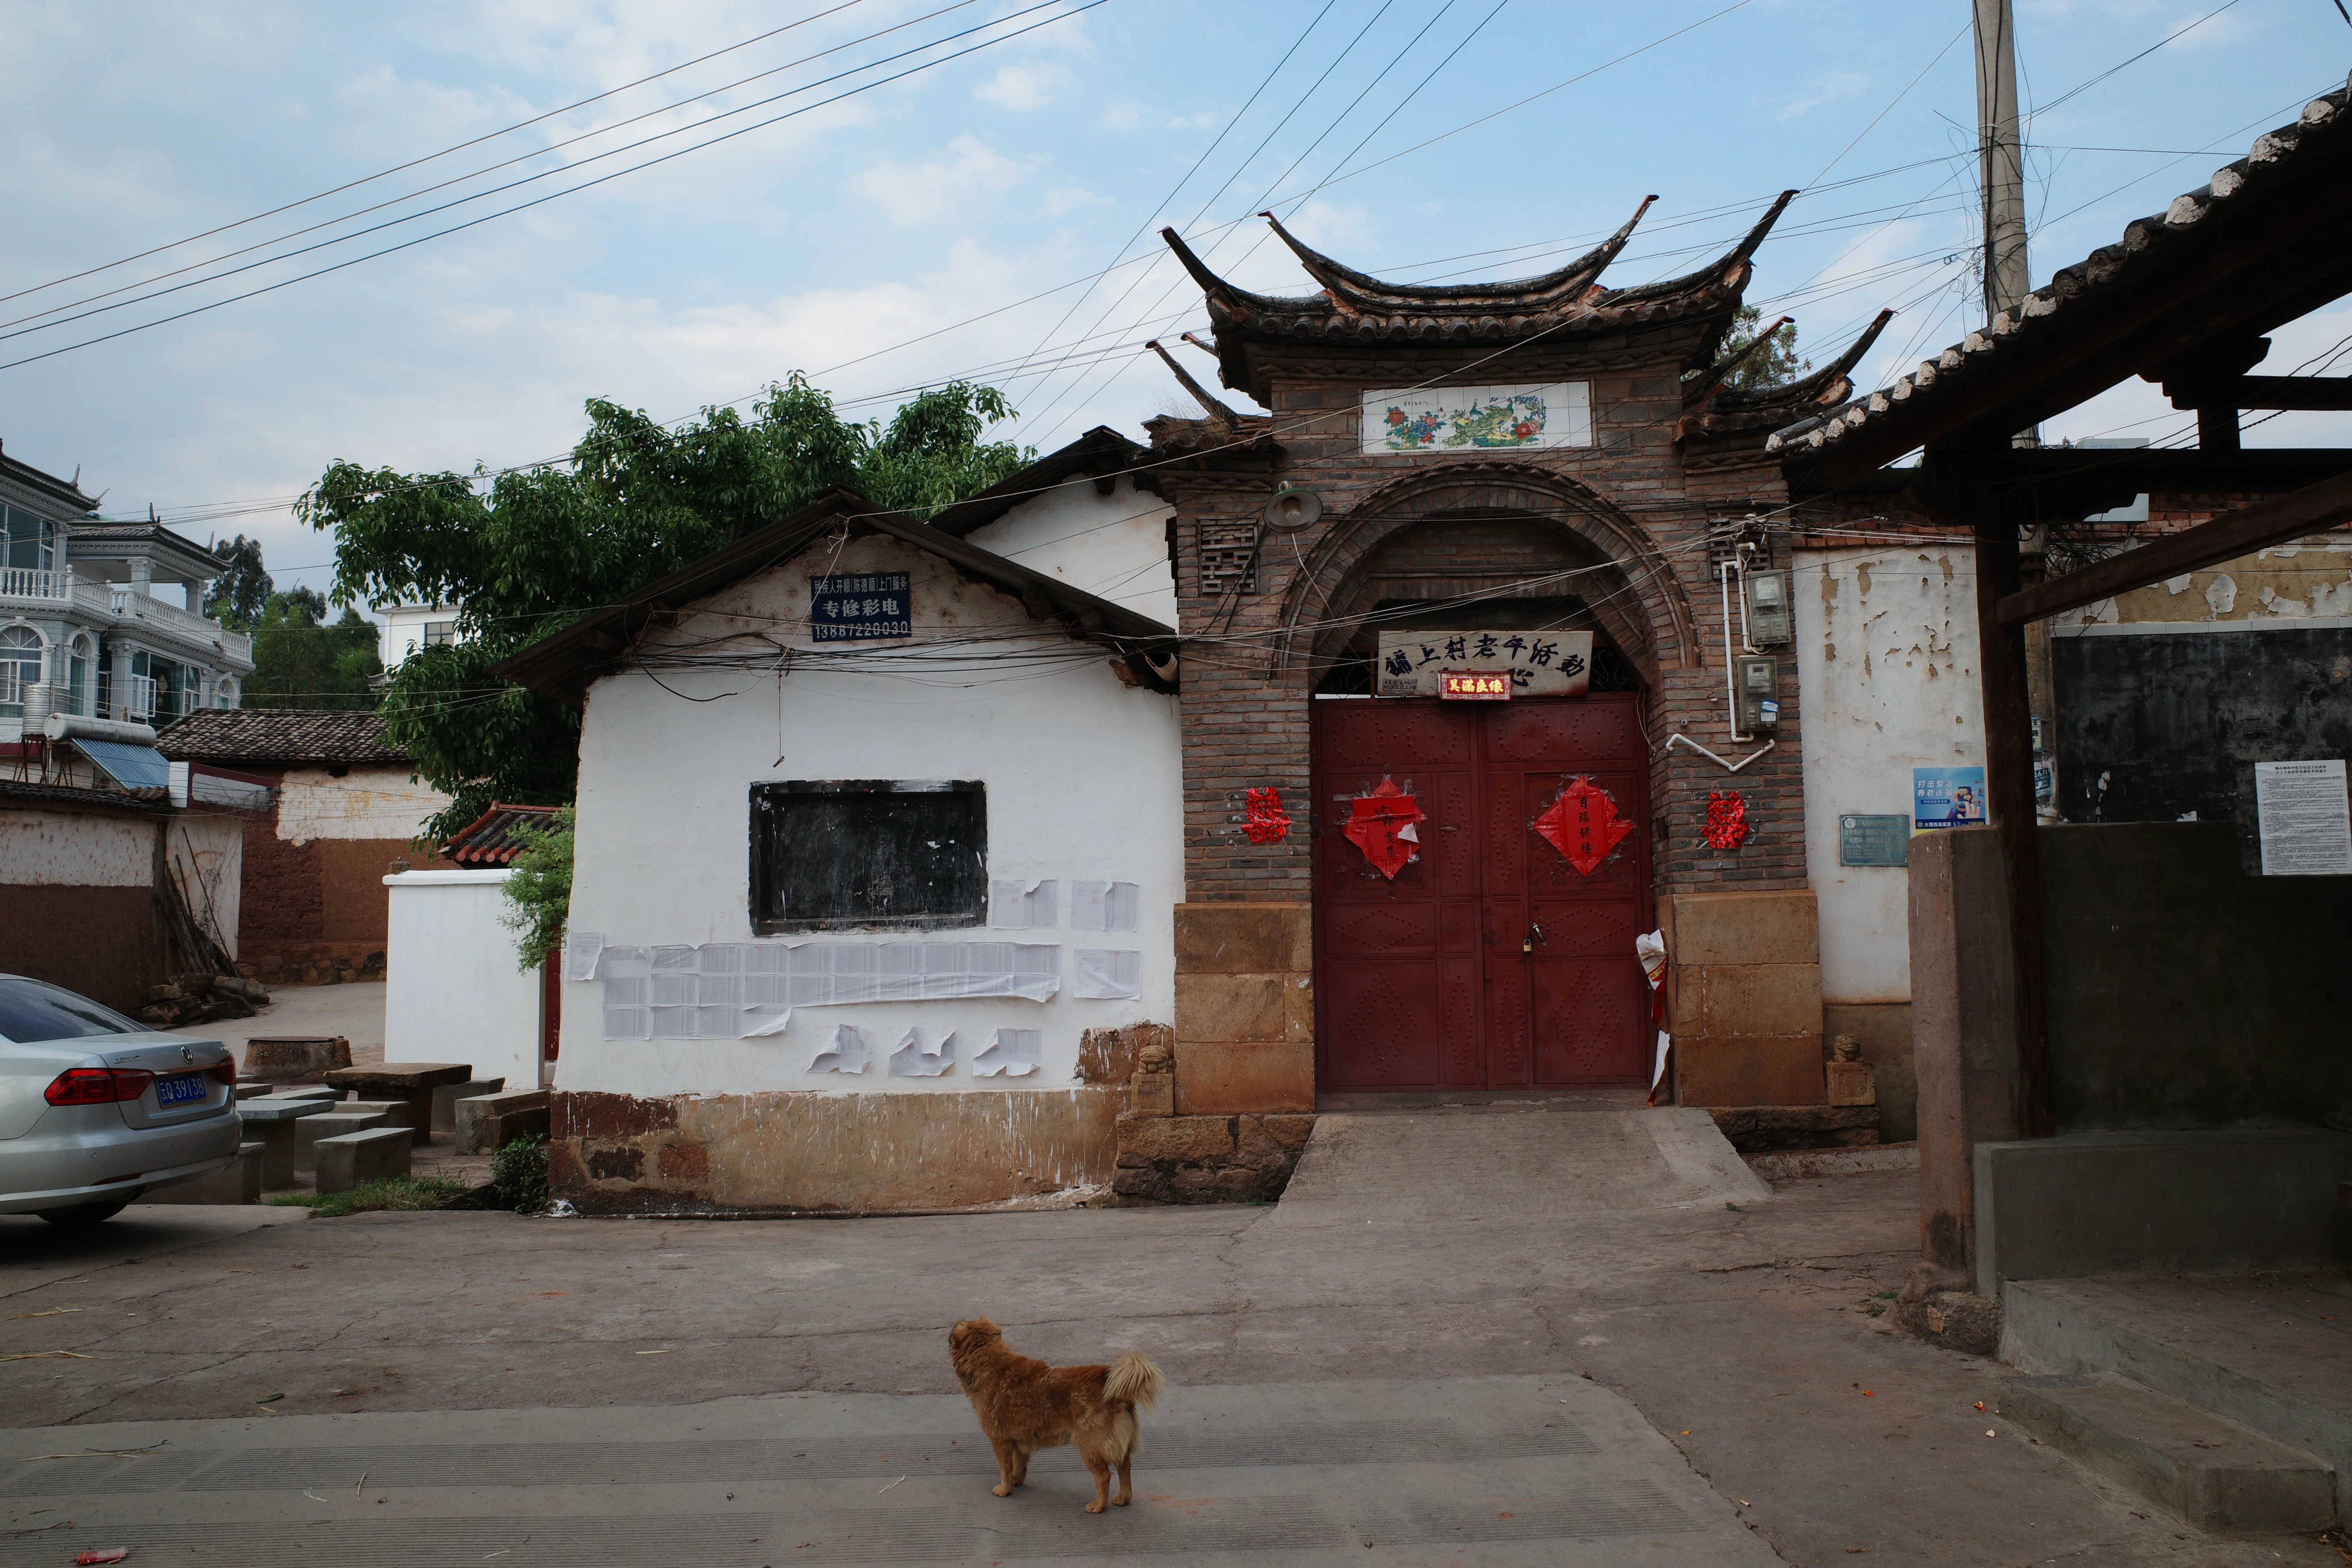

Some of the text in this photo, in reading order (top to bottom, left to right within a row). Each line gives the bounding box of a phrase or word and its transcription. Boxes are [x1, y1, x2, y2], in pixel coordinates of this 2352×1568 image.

[822, 598, 900, 618] 专修彩电
[815, 621, 907, 639] 13887220030
[1918, 780, 1953, 788] 打击整治
[1917, 789, 1953, 797] 养老诈骗
